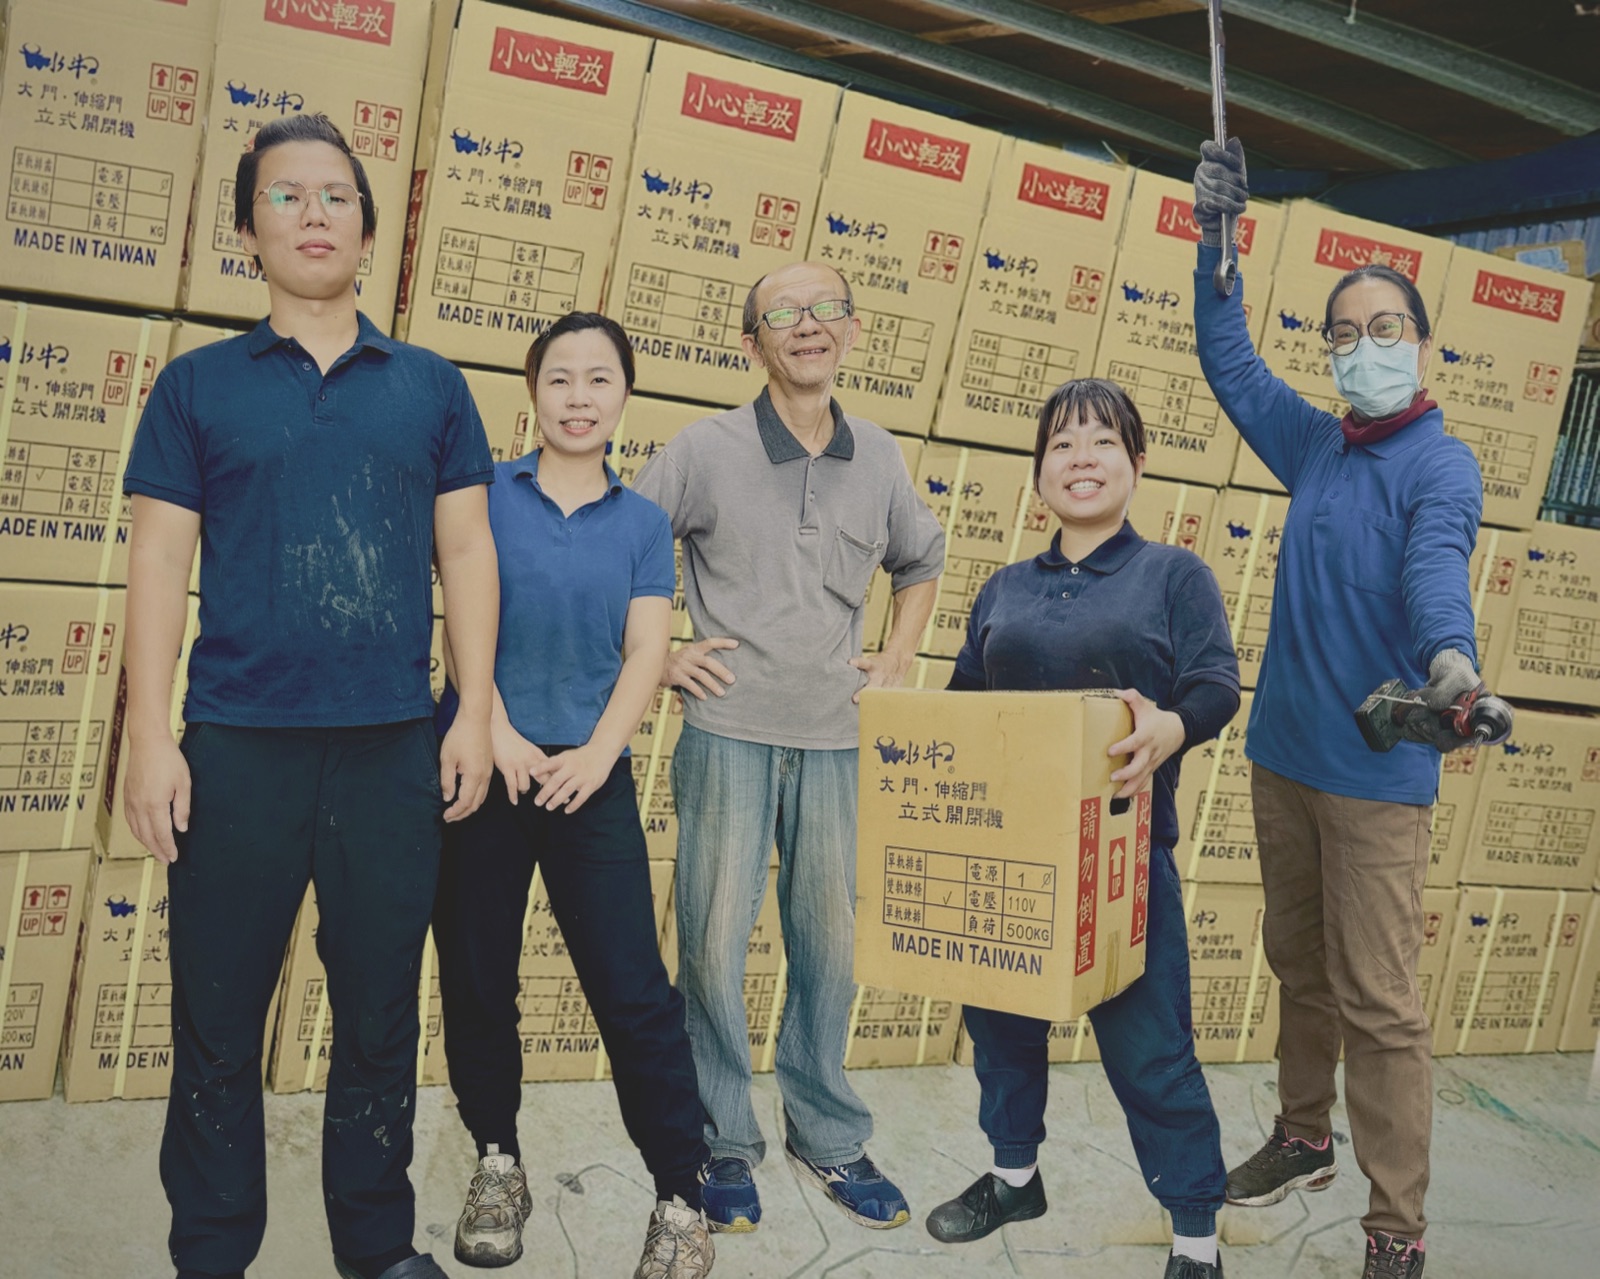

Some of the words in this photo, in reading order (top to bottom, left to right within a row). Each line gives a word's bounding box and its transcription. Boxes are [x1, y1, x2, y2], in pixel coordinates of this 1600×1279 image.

[497, 36, 605, 88] 小心輕放
[151, 99, 167, 114] UP
[689, 82, 793, 134] 小心輕放
[35, 108, 136, 138] 立式開閉機
[356, 137, 371, 151] UP
[870, 128, 962, 176] 小心輕放
[98, 167, 124, 184] 電源
[95, 191, 121, 210] 電壓
[567, 185, 582, 200] UP
[1023, 171, 1103, 214] 小心輕放
[461, 190, 552, 220] 立式開閉機
[150, 225, 164, 238] KG
[755, 226, 770, 240] UP
[14, 227, 66, 253] MADE
[69, 236, 87, 256] IN
[92, 240, 157, 267] TAIWAN
[560, 300, 573, 312] KG
[1478, 276, 1560, 317] 小心輕放
[438, 302, 483, 326] MADE
[487, 311, 502, 329] IN
[507, 313, 552, 337] TAIWA
[628, 334, 671, 359] MADE
[675, 343, 690, 361] IN
[695, 348, 750, 373] TAIWAN
[107, 386, 123, 400] UP
[848, 372, 862, 391] IN
[864, 376, 915, 400] TAIWAN
[965, 392, 999, 414] MADE
[1002, 401, 1015, 416] IN
[1161, 432, 1207, 453] TAIWAN
[71, 451, 97, 469] 電源
[68, 474, 93, 493] 電壓
[64, 496, 90, 514] 負荷
[41, 519, 59, 539] IN
[64, 522, 128, 544] TAIWN
[67, 654, 83, 669] UP
[1519, 658, 1552, 675] MADE
[1555, 662, 1567, 677] IN
[30, 725, 55, 742] 電源
[26, 747, 51, 764] 電壓
[906, 739, 955, 770] 水牛
[23, 769, 48, 786] 負荷
[21, 793, 85, 812] TAIWAN
[898, 802, 1004, 829] 立式開閉機
[1238, 845, 1253, 861] IN
[1486, 850, 1519, 865] MADE
[1522, 852, 1534, 865] IN
[1537, 852, 1581, 868] TAIWAN
[970, 863, 998, 882] 電源
[1132, 796, 1150, 942] 此端向上
[1018, 872, 1025, 888] 1
[1077, 801, 1098, 972] 請勿倒置
[1111, 878, 1121, 897] UP
[968, 890, 997, 910] 電壓
[1008, 896, 1036, 913] 110V
[23, 918, 39, 931] UP
[968, 915, 996, 935] 負荷
[1006, 923, 1049, 941] 500KG
[892, 932, 942, 959] MADE
[946, 941, 964, 962] IN
[969, 944, 1043, 976] TAIWAN
[854, 1023, 880, 1039] ADE
[536, 1037, 551, 1055] IN
[555, 1036, 600, 1055] TAIWA
[152, 1052, 169, 1068] IN
